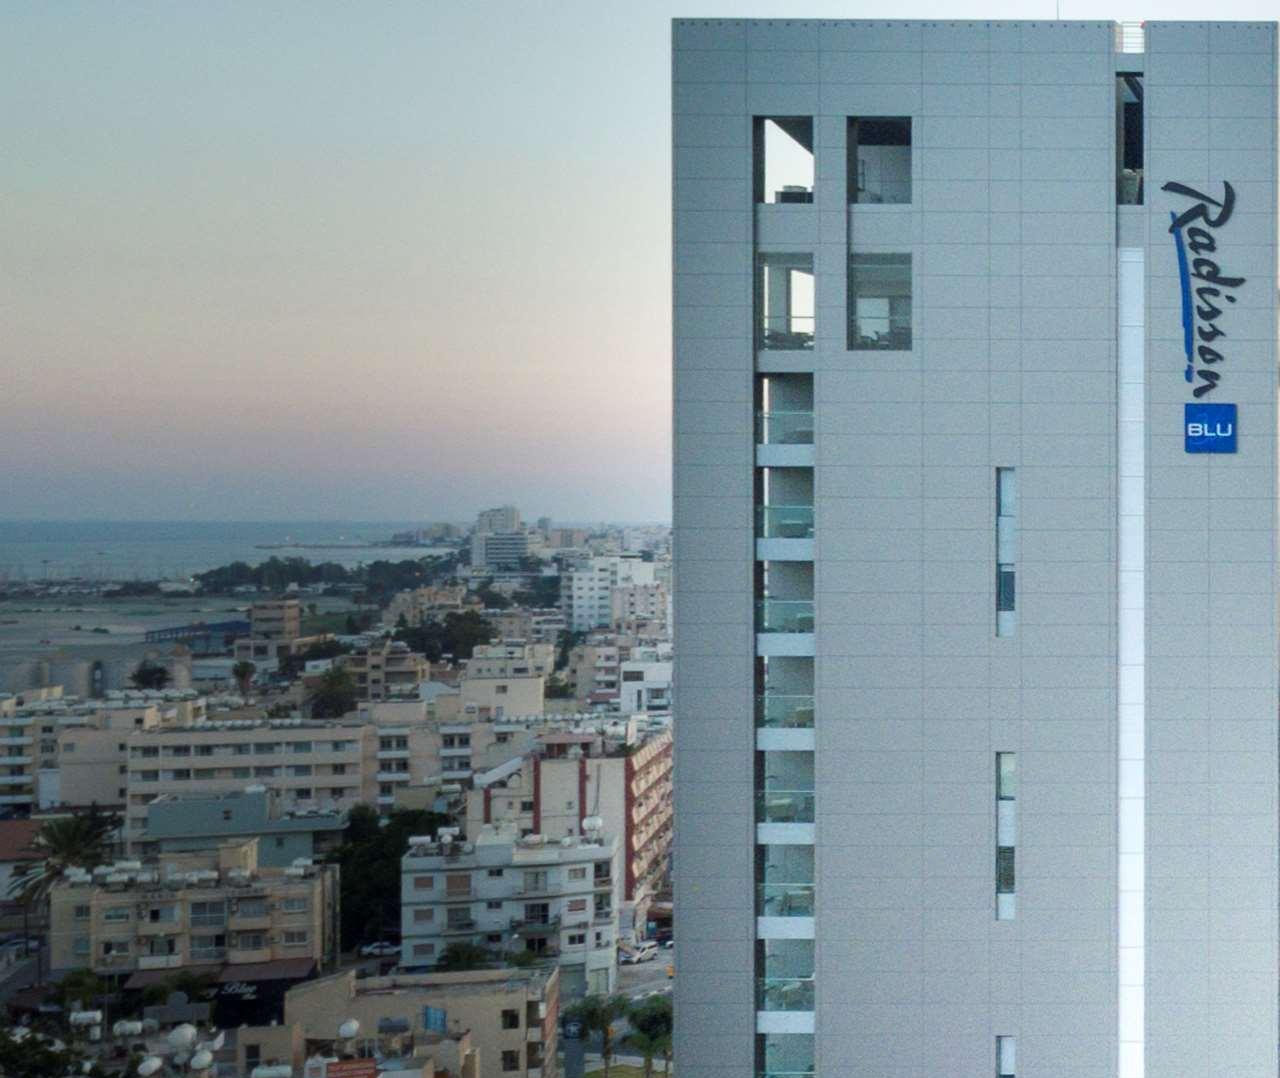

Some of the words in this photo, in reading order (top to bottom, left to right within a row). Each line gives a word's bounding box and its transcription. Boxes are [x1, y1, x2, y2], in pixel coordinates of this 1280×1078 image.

[1161, 180, 1246, 398] Radisson
[1187, 423, 1233, 436] BLU
[223, 982, 257, 993] Blue
